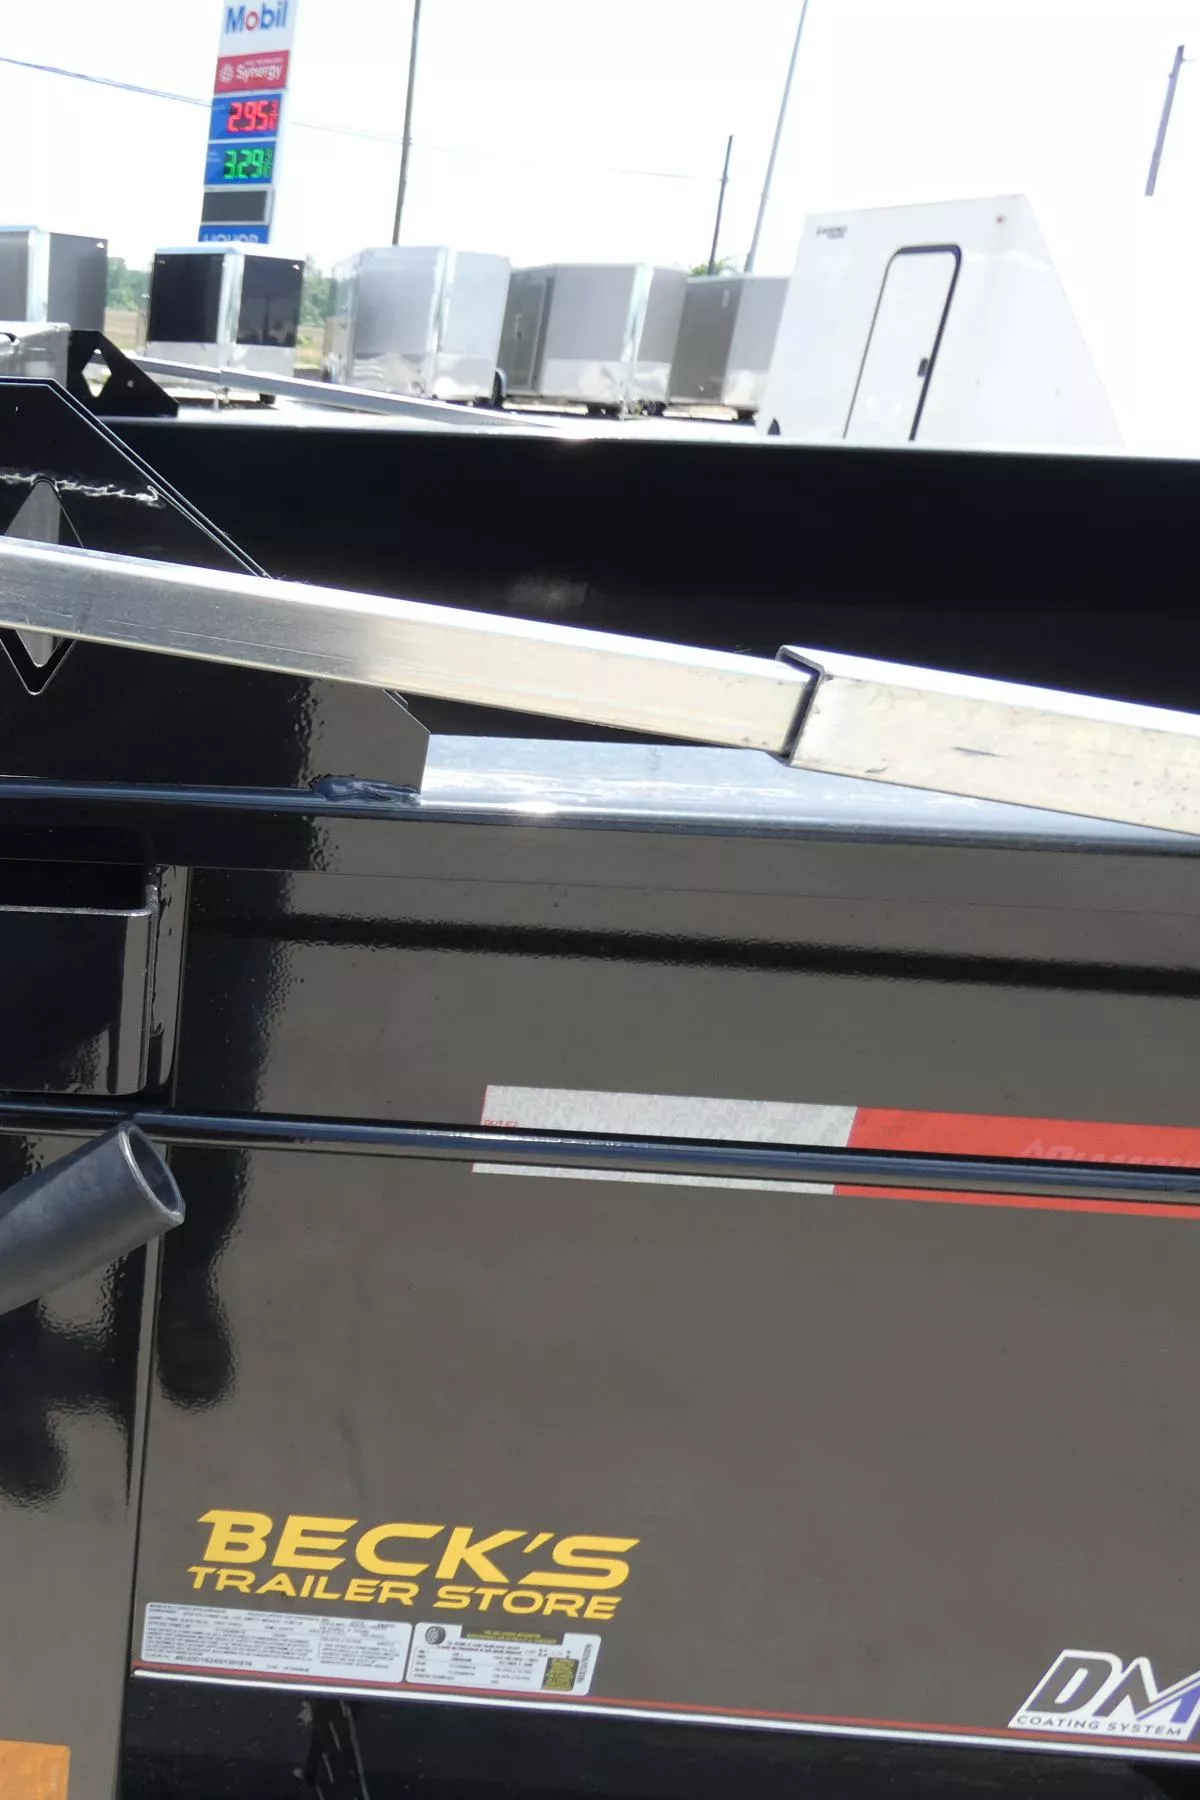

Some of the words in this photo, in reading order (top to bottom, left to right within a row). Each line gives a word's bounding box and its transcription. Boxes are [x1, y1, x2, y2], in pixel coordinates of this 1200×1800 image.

[225, 1, 288, 33] Mobil
[236, 63, 282, 84] Synergy
[187, 1566, 419, 1606] TRAILER
[432, 1585, 622, 1620] STORE
[1016, 1715, 1100, 1730] COATING
[1107, 1721, 1182, 1737] SYSTEM
